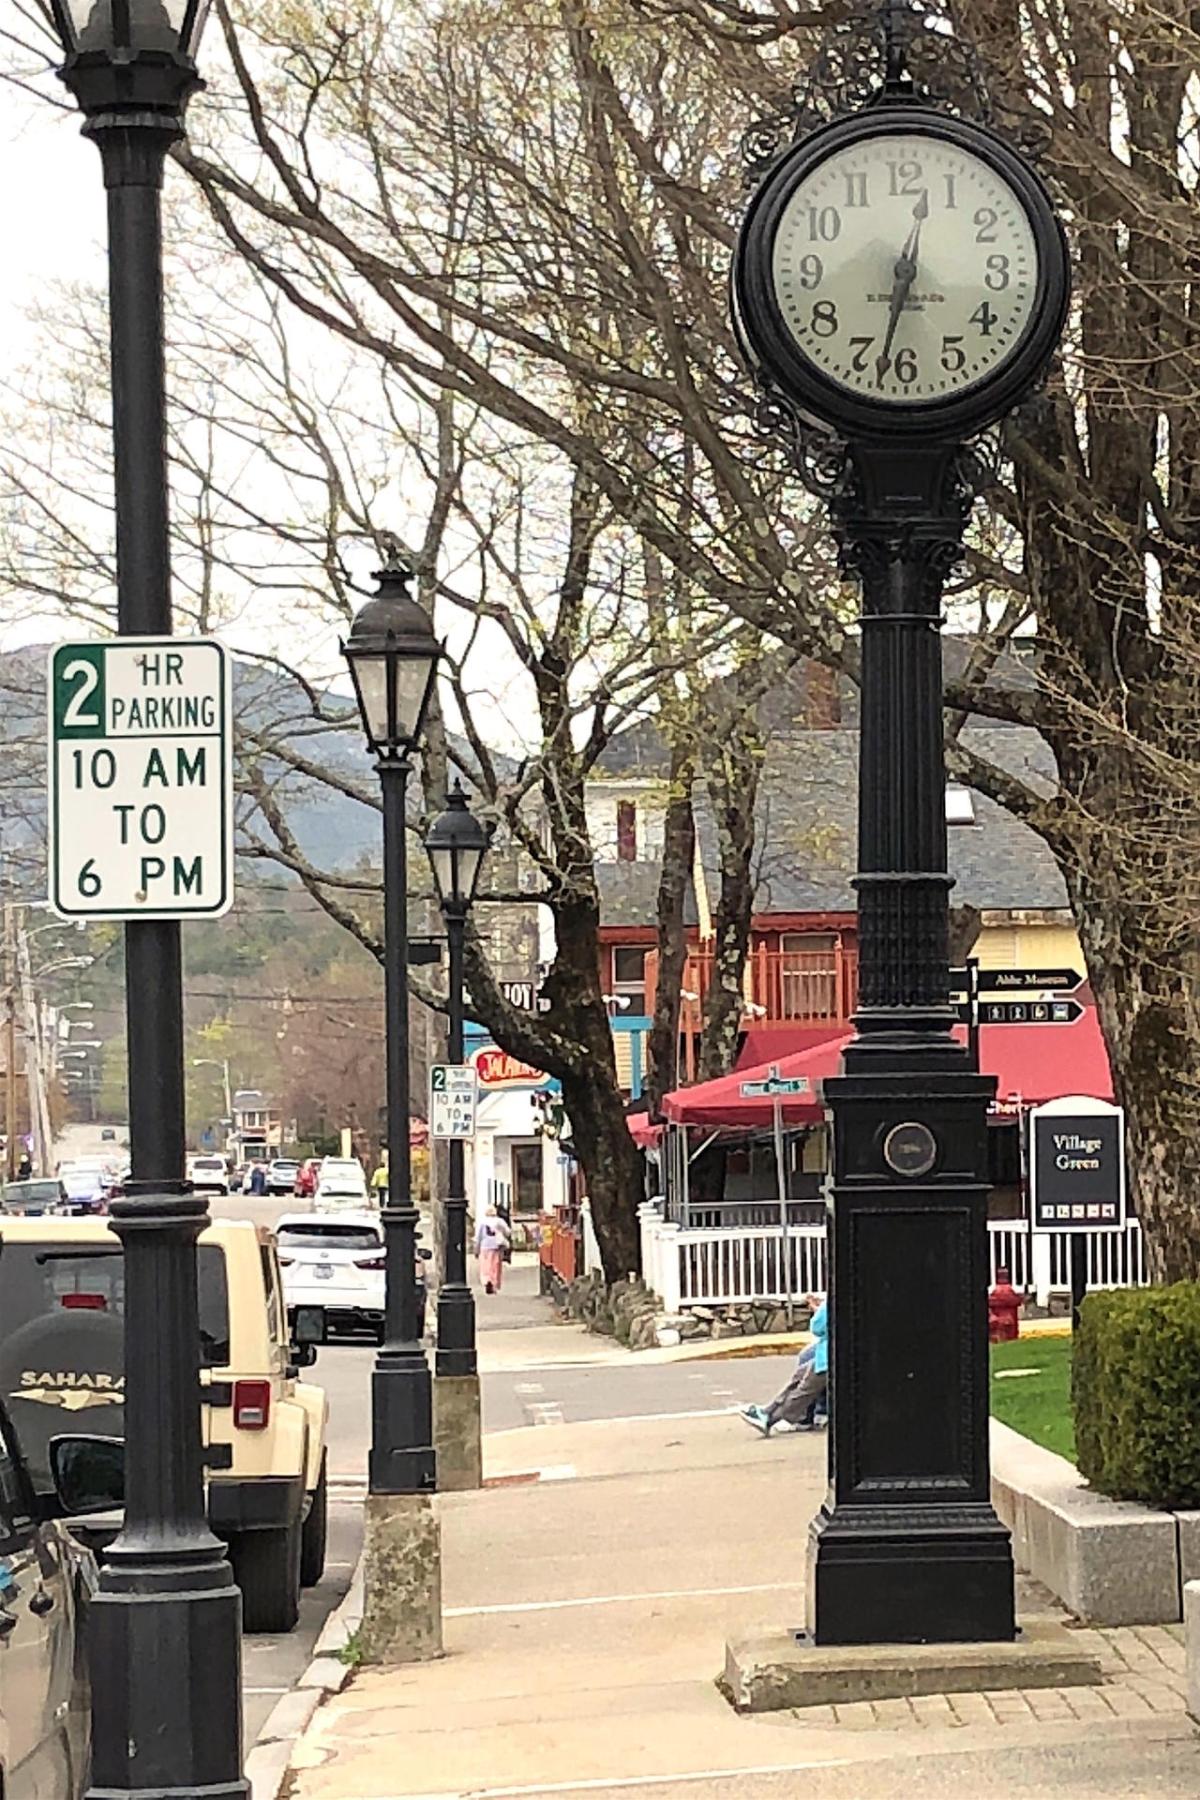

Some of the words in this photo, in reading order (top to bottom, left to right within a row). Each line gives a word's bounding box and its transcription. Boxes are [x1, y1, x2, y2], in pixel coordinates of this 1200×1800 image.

[844, 172, 870, 208] 11
[886, 160, 923, 196] 12
[944, 174, 957, 208] 1
[808, 207, 841, 241] 10
[973, 208, 998, 244] 2
[800, 254, 823, 290] 9
[985, 254, 1010, 290] 3
[811, 301, 838, 337] 8
[969, 301, 998, 336] 4
[848, 337, 875, 372] 7
[894, 348, 918, 383] 6
[941, 336, 966, 371] 5
[62, 659, 99, 726] 2
[140, 654, 183, 685] HR
[112, 696, 215, 729] PARKING
[73, 748, 116, 789] 10
[142, 748, 206, 788] AM
[113, 804, 166, 844] TO
[78, 858, 102, 898] 6
[140, 856, 202, 896] PM
[434, 1070, 444, 1089] 2
[1053, 1135, 1102, 1153] Village
[1056, 1154, 1100, 1170] Green
